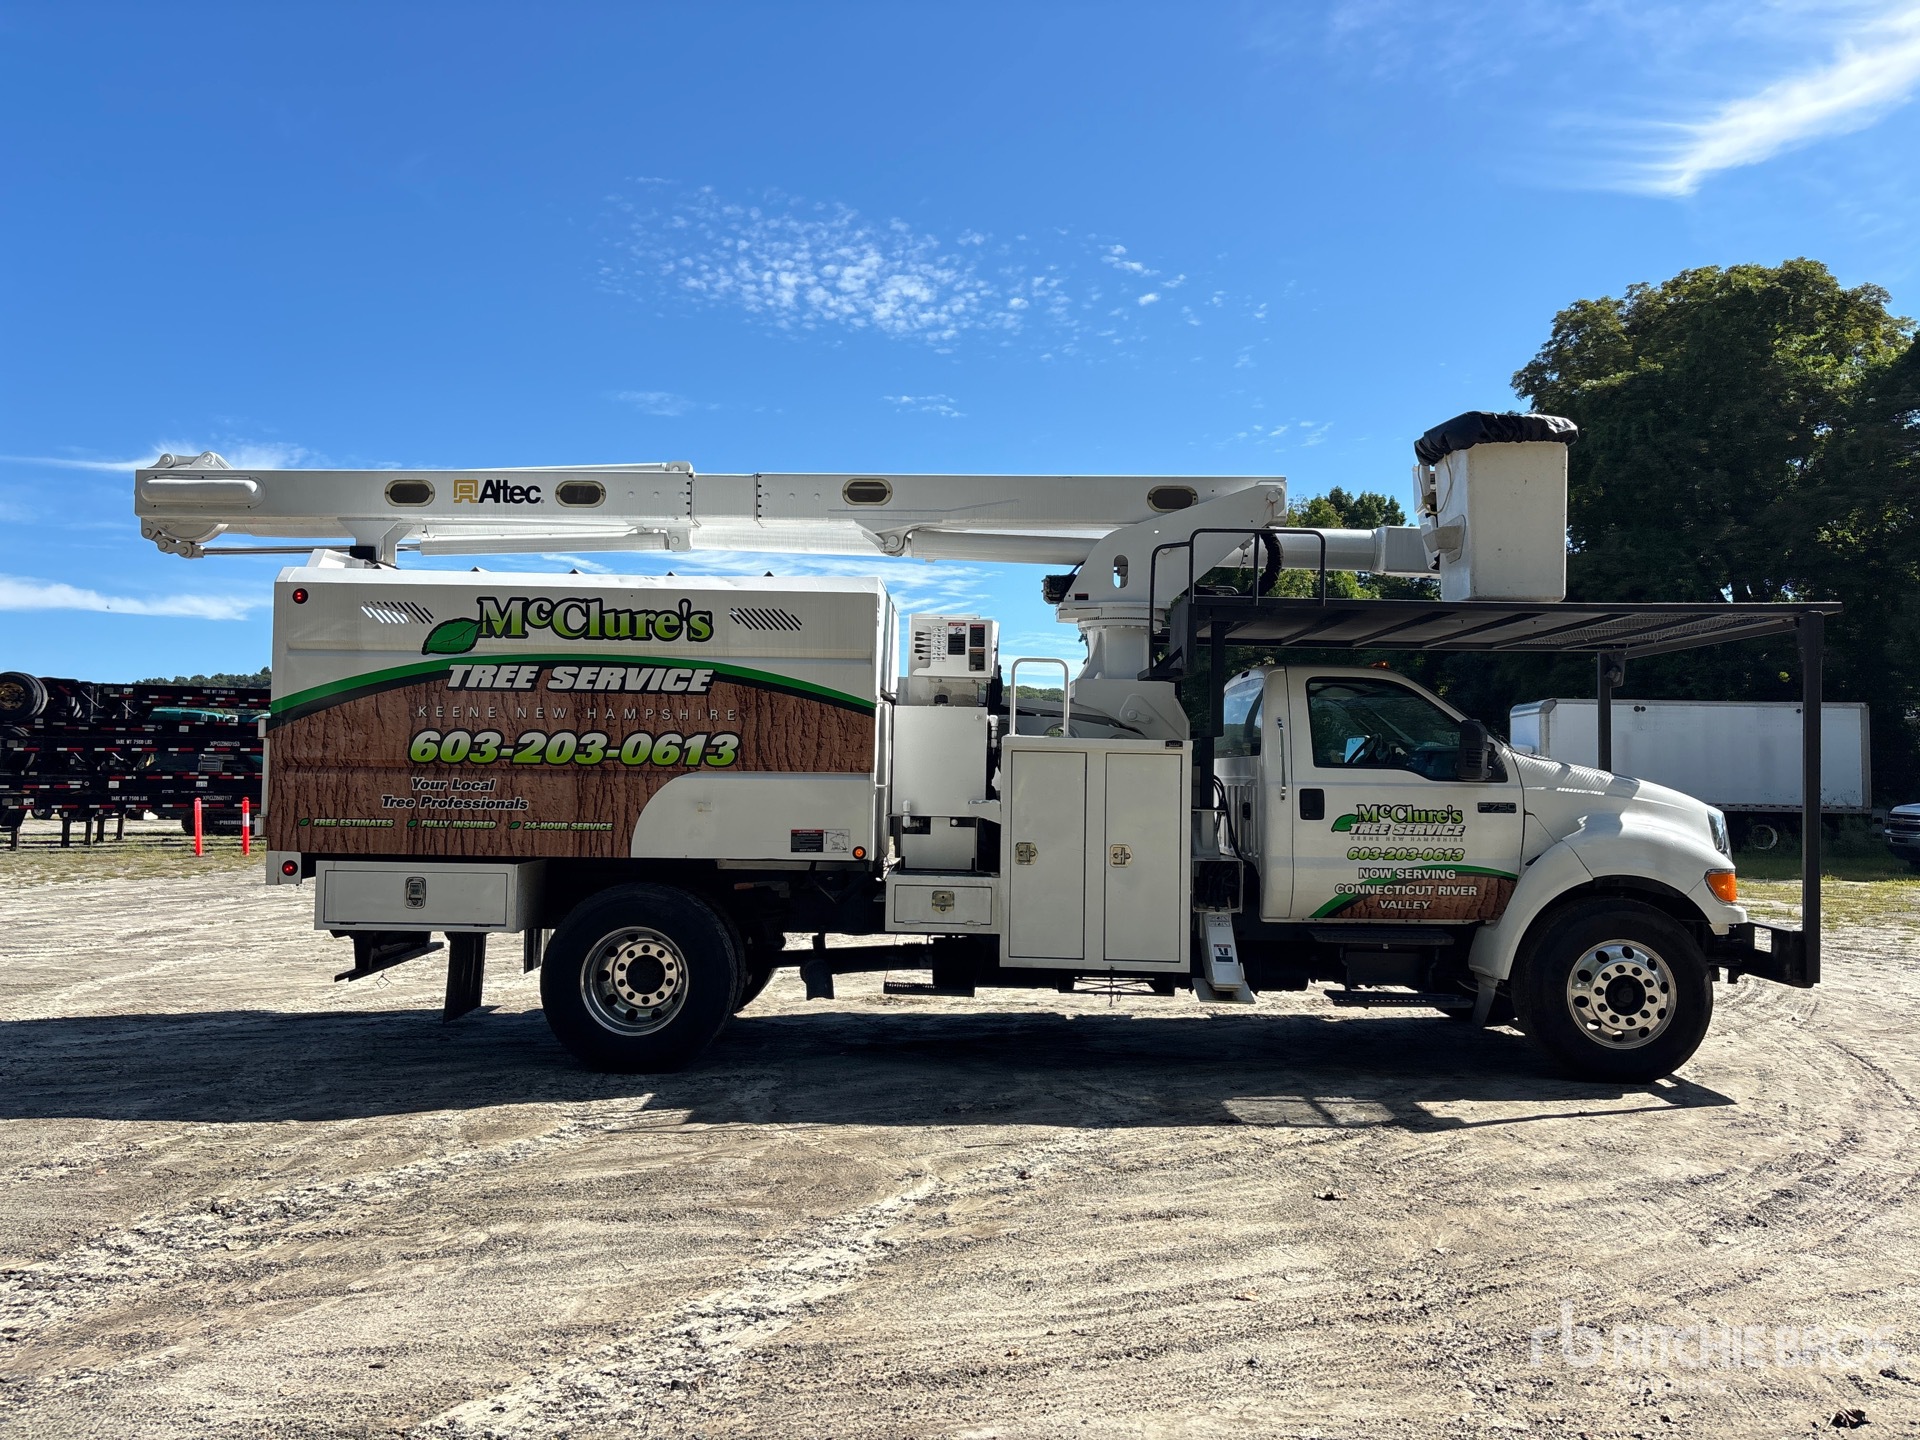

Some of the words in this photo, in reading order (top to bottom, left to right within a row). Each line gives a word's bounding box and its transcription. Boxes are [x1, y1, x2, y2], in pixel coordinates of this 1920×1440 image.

[478, 479, 541, 504] Altec
[477, 596, 714, 642] McClure's
[447, 663, 542, 692] TREE
[547, 666, 714, 694] SERVICE
[418, 705, 497, 718] KEENE
[517, 706, 568, 719] NEW
[587, 707, 736, 721] HAMPSHIRE
[407, 727, 741, 768] 603-203-0613
[411, 777, 447, 791] Your
[452, 778, 496, 792] Local
[381, 795, 415, 808] Tree
[419, 795, 528, 810] Professionals
[1356, 804, 1463, 824] McClure's
[312, 818, 338, 827] FREE
[339, 818, 394, 828] ESTIMATES
[420, 819, 449, 828] FULLY
[452, 820, 497, 829] INSURED
[523, 821, 569, 830] 24-HOUR
[570, 822, 613, 831] SERVICE
[1349, 823, 1390, 835] TREE
[1392, 823, 1466, 837] SERVICE
[1346, 847, 1466, 862] 603-203-0613
[1358, 867, 1394, 880] NOW
[1396, 868, 1456, 880] SERVING
[1334, 884, 1433, 896] CONNECTICUT
[1437, 885, 1478, 897] RIVER
[1379, 899, 1431, 910] VALLEY
